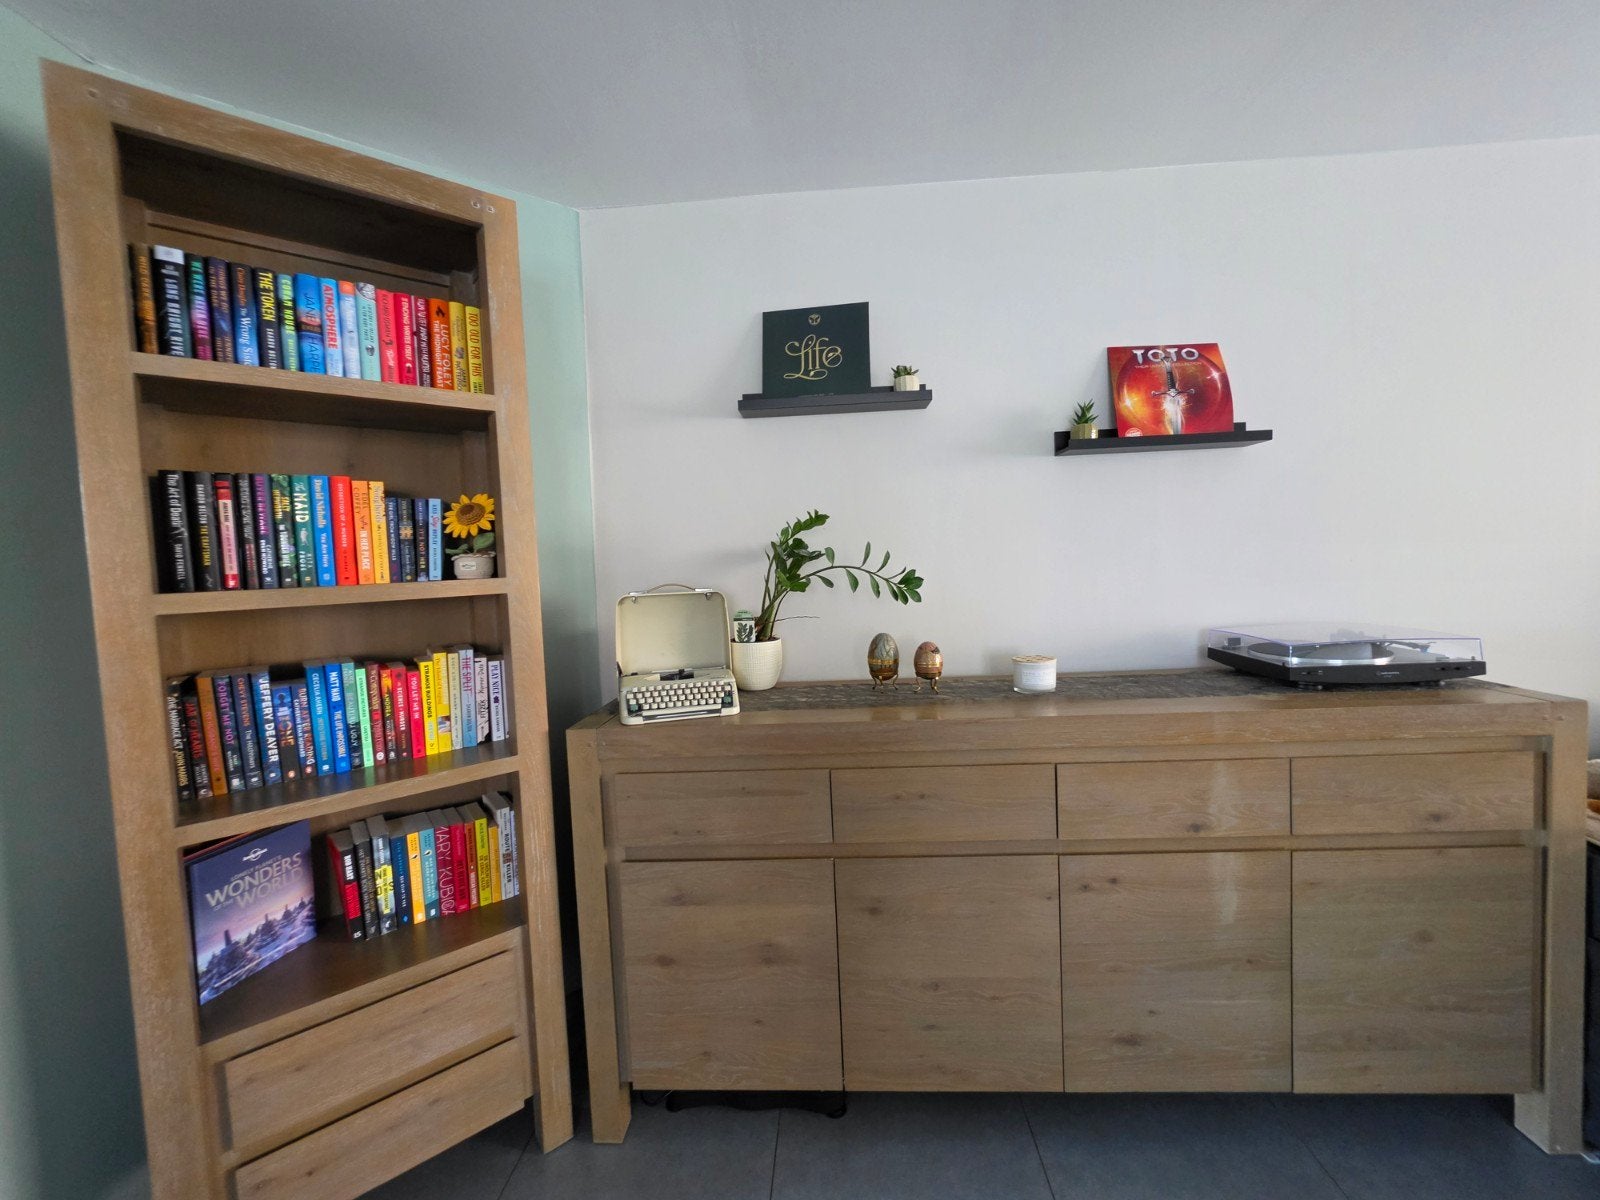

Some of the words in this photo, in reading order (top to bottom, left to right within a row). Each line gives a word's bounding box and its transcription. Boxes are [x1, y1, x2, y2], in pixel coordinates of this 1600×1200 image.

[192, 262, 202, 271] WE
[164, 278, 179, 299] LONG
[193, 274, 205, 292] WERE
[258, 272, 274, 289] THE
[282, 279, 292, 306] CORAM
[195, 295, 208, 318] NEVER
[260, 292, 276, 321] TOKEN
[304, 293, 317, 319] JANE
[402, 302, 410, 324] ENDING
[167, 302, 182, 333] BRIGHT
[284, 310, 294, 335] HOUSE
[323, 284, 337, 350] ATMOSPHERE
[468, 313, 478, 325] TOO
[198, 320, 209, 339] HERE
[240, 318, 252, 344] Wrong
[266, 328, 274, 348] SHARON
[441, 324, 449, 350] LUCY
[470, 330, 479, 343] OLD
[170, 336, 184, 356] RIVE
[404, 345, 412, 360] ITSELF
[471, 346, 480, 359] FOR
[1132, 348, 1199, 364] TOTO
[243, 347, 253, 366] Siste
[784, 334, 842, 380] Life
[443, 353, 451, 386] FOLEY
[472, 363, 481, 376] THIS
[167, 474, 179, 485] The
[168, 487, 181, 498] Art
[196, 484, 204, 504] SHARON
[172, 508, 183, 527] Death
[198, 505, 207, 524] BOLTON
[294, 493, 309, 523] MAID
[317, 501, 326, 528] Nicholls
[200, 525, 208, 534] THE
[360, 530, 368, 538] IN
[201, 536, 210, 566] CRAFTSMAN
[361, 539, 369, 550] HER
[362, 552, 370, 570] PLACE
[462, 657, 472, 671] THE
[237, 678, 245, 698] CHEVY
[312, 673, 320, 696] CECELIA
[330, 672, 340, 688] MATT
[463, 672, 474, 693] SPLIT
[492, 681, 500, 695] NICE
[218, 681, 229, 711] FORGET
[259, 678, 273, 719] JEFFERY
[299, 688, 308, 707] BURN
[331, 688, 340, 702] HAIG
[186, 703, 197, 716] JAR
[240, 700, 249, 726] STEVENS
[334, 711, 342, 720] THE
[222, 715, 231, 726] ME
[302, 710, 310, 731] AFTER
[335, 720, 343, 730] LIFE
[190, 730, 202, 758] HEARTS
[224, 729, 234, 745] NOT
[265, 724, 279, 762] DEAVER
[336, 731, 346, 758] IMPOSSIBLE
[173, 751, 184, 766] JOHN
[304, 734, 314, 764] READING
[176, 766, 188, 786] MARRS
[206, 853, 302, 906] WONDERS
[237, 868, 303, 908] WORLD
